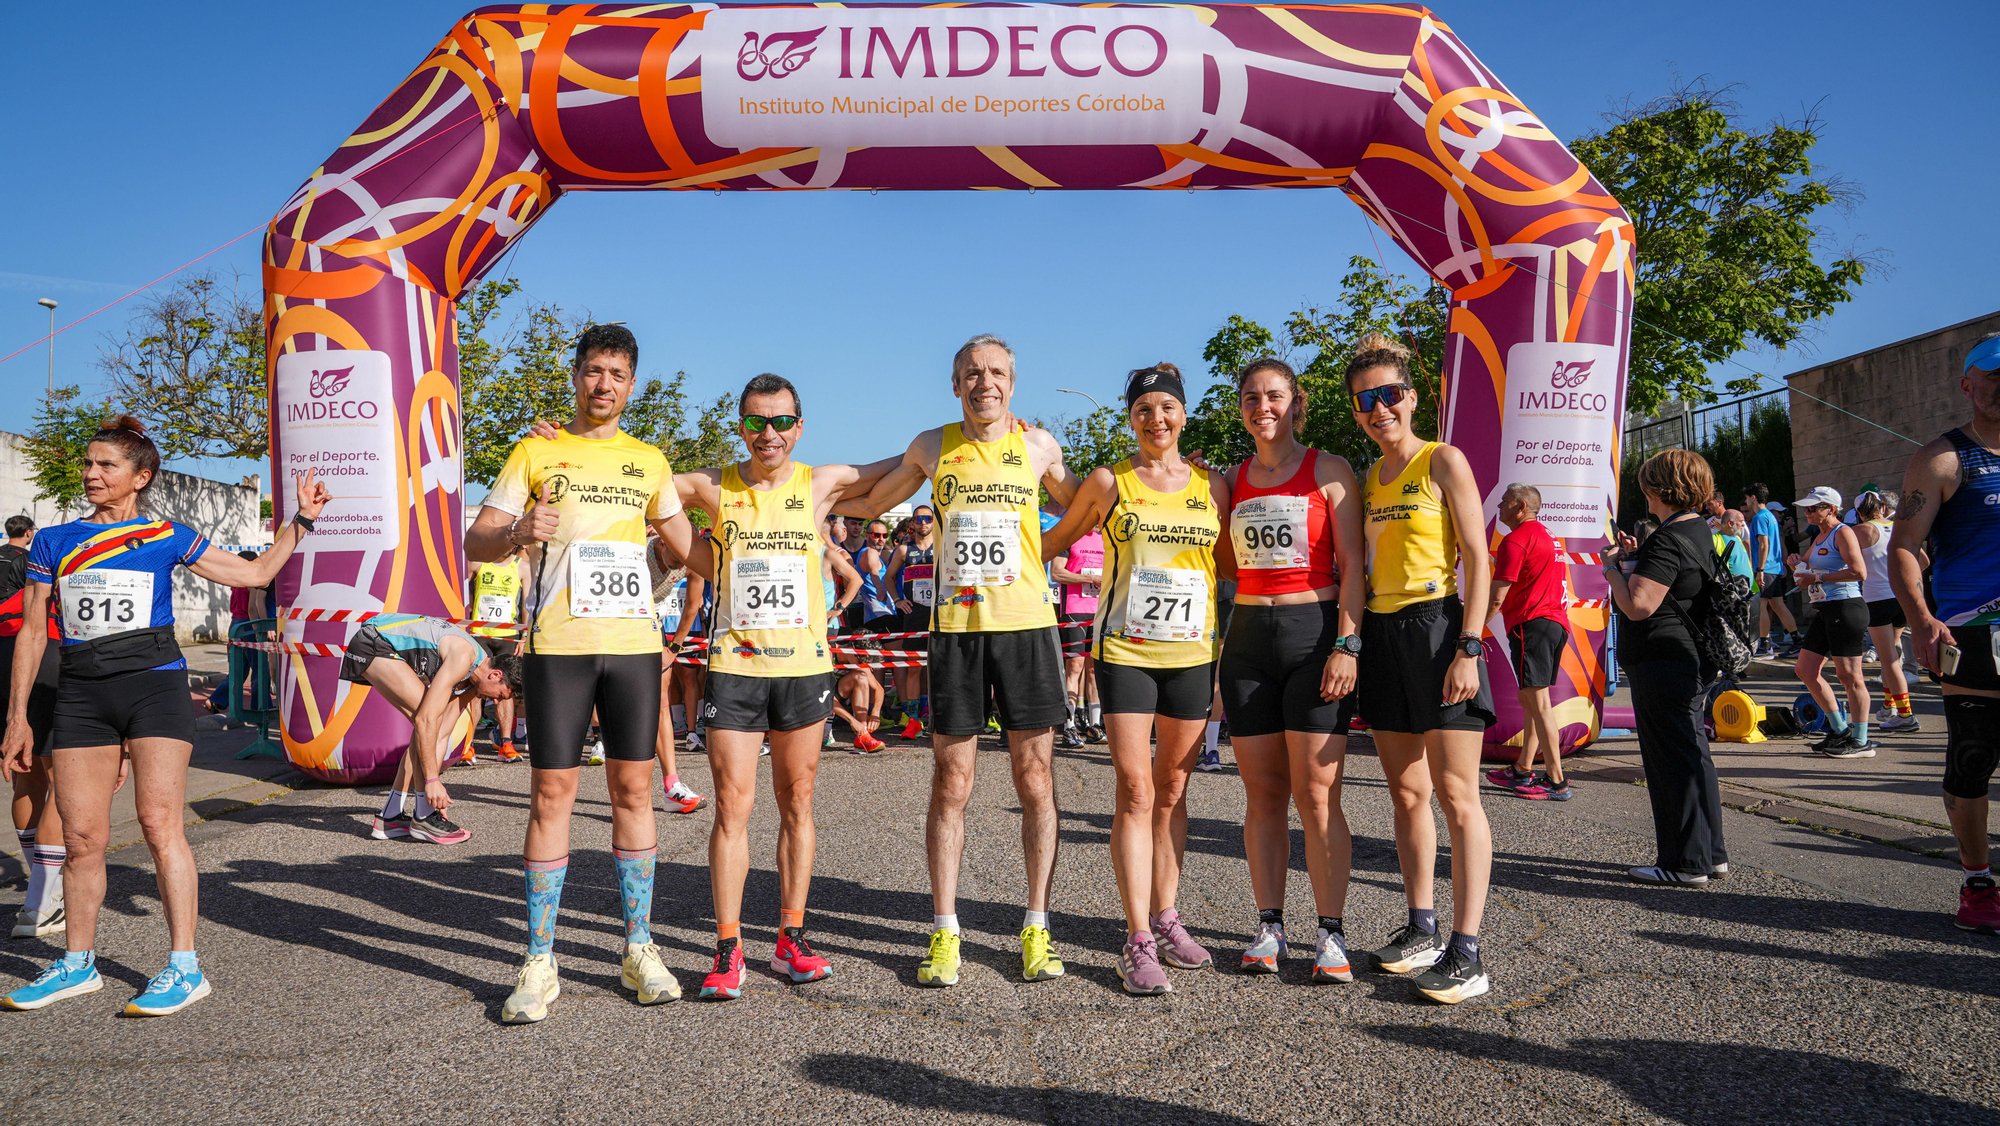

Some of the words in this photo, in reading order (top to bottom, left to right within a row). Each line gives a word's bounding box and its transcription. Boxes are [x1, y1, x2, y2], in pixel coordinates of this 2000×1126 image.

[837, 25, 1168, 80] IMDECO
[739, 97, 825, 115] Instituto
[832, 96, 934, 118] Municipal
[941, 95, 968, 113] de
[974, 95, 1070, 117] Deportes
[1077, 93, 1166, 113] Córdoba
[1519, 392, 1607, 412] IMDECO
[287, 401, 378, 422] IMDECO
[1516, 440, 1539, 450] Por
[1542, 440, 1553, 450] el
[1556, 440, 1602, 453] Deporte.
[290, 453, 307, 464] Por
[309, 451, 319, 462] el
[322, 450, 380, 463] Deporte.
[1515, 454, 1538, 464] Por
[1541, 454, 1594, 466] Córdoba.
[291, 467, 307, 478] Por
[312, 465, 369, 477] Córdoba.
[570, 484, 599, 493] CLUB
[601, 486, 650, 501] ATLETISMO
[957, 484, 983, 493] CLUB
[986, 483, 1033, 496] ATLETISMO
[580, 494, 643, 509] MONTILLA
[966, 494, 1027, 506] MONTILLA
[1382, 505, 1419, 513] ATLETISMO
[1372, 513, 1412, 523] MONTILLA
[739, 531, 764, 540] CLUB
[766, 531, 814, 541] ATLETISMO
[1139, 524, 1167, 532] CLUB
[1170, 525, 1217, 538] ATLETISMO
[1244, 524, 1293, 550] 966
[746, 542, 808, 551] MONTILLA
[1148, 535, 1212, 547] MONTILLA
[954, 541, 1005, 565] 396
[738, 561, 764, 569] carreras
[738, 566, 770, 575] populares
[1138, 576, 1172, 584] populares
[1139, 571, 1167, 580] carreras
[589, 571, 640, 597] 386
[671, 599, 686, 608] 51
[746, 585, 795, 609] 345
[77, 597, 135, 622] 813
[488, 607, 502, 617] 70
[1143, 596, 1191, 622] 271
[1401, 937, 1434, 960] BROOKS
